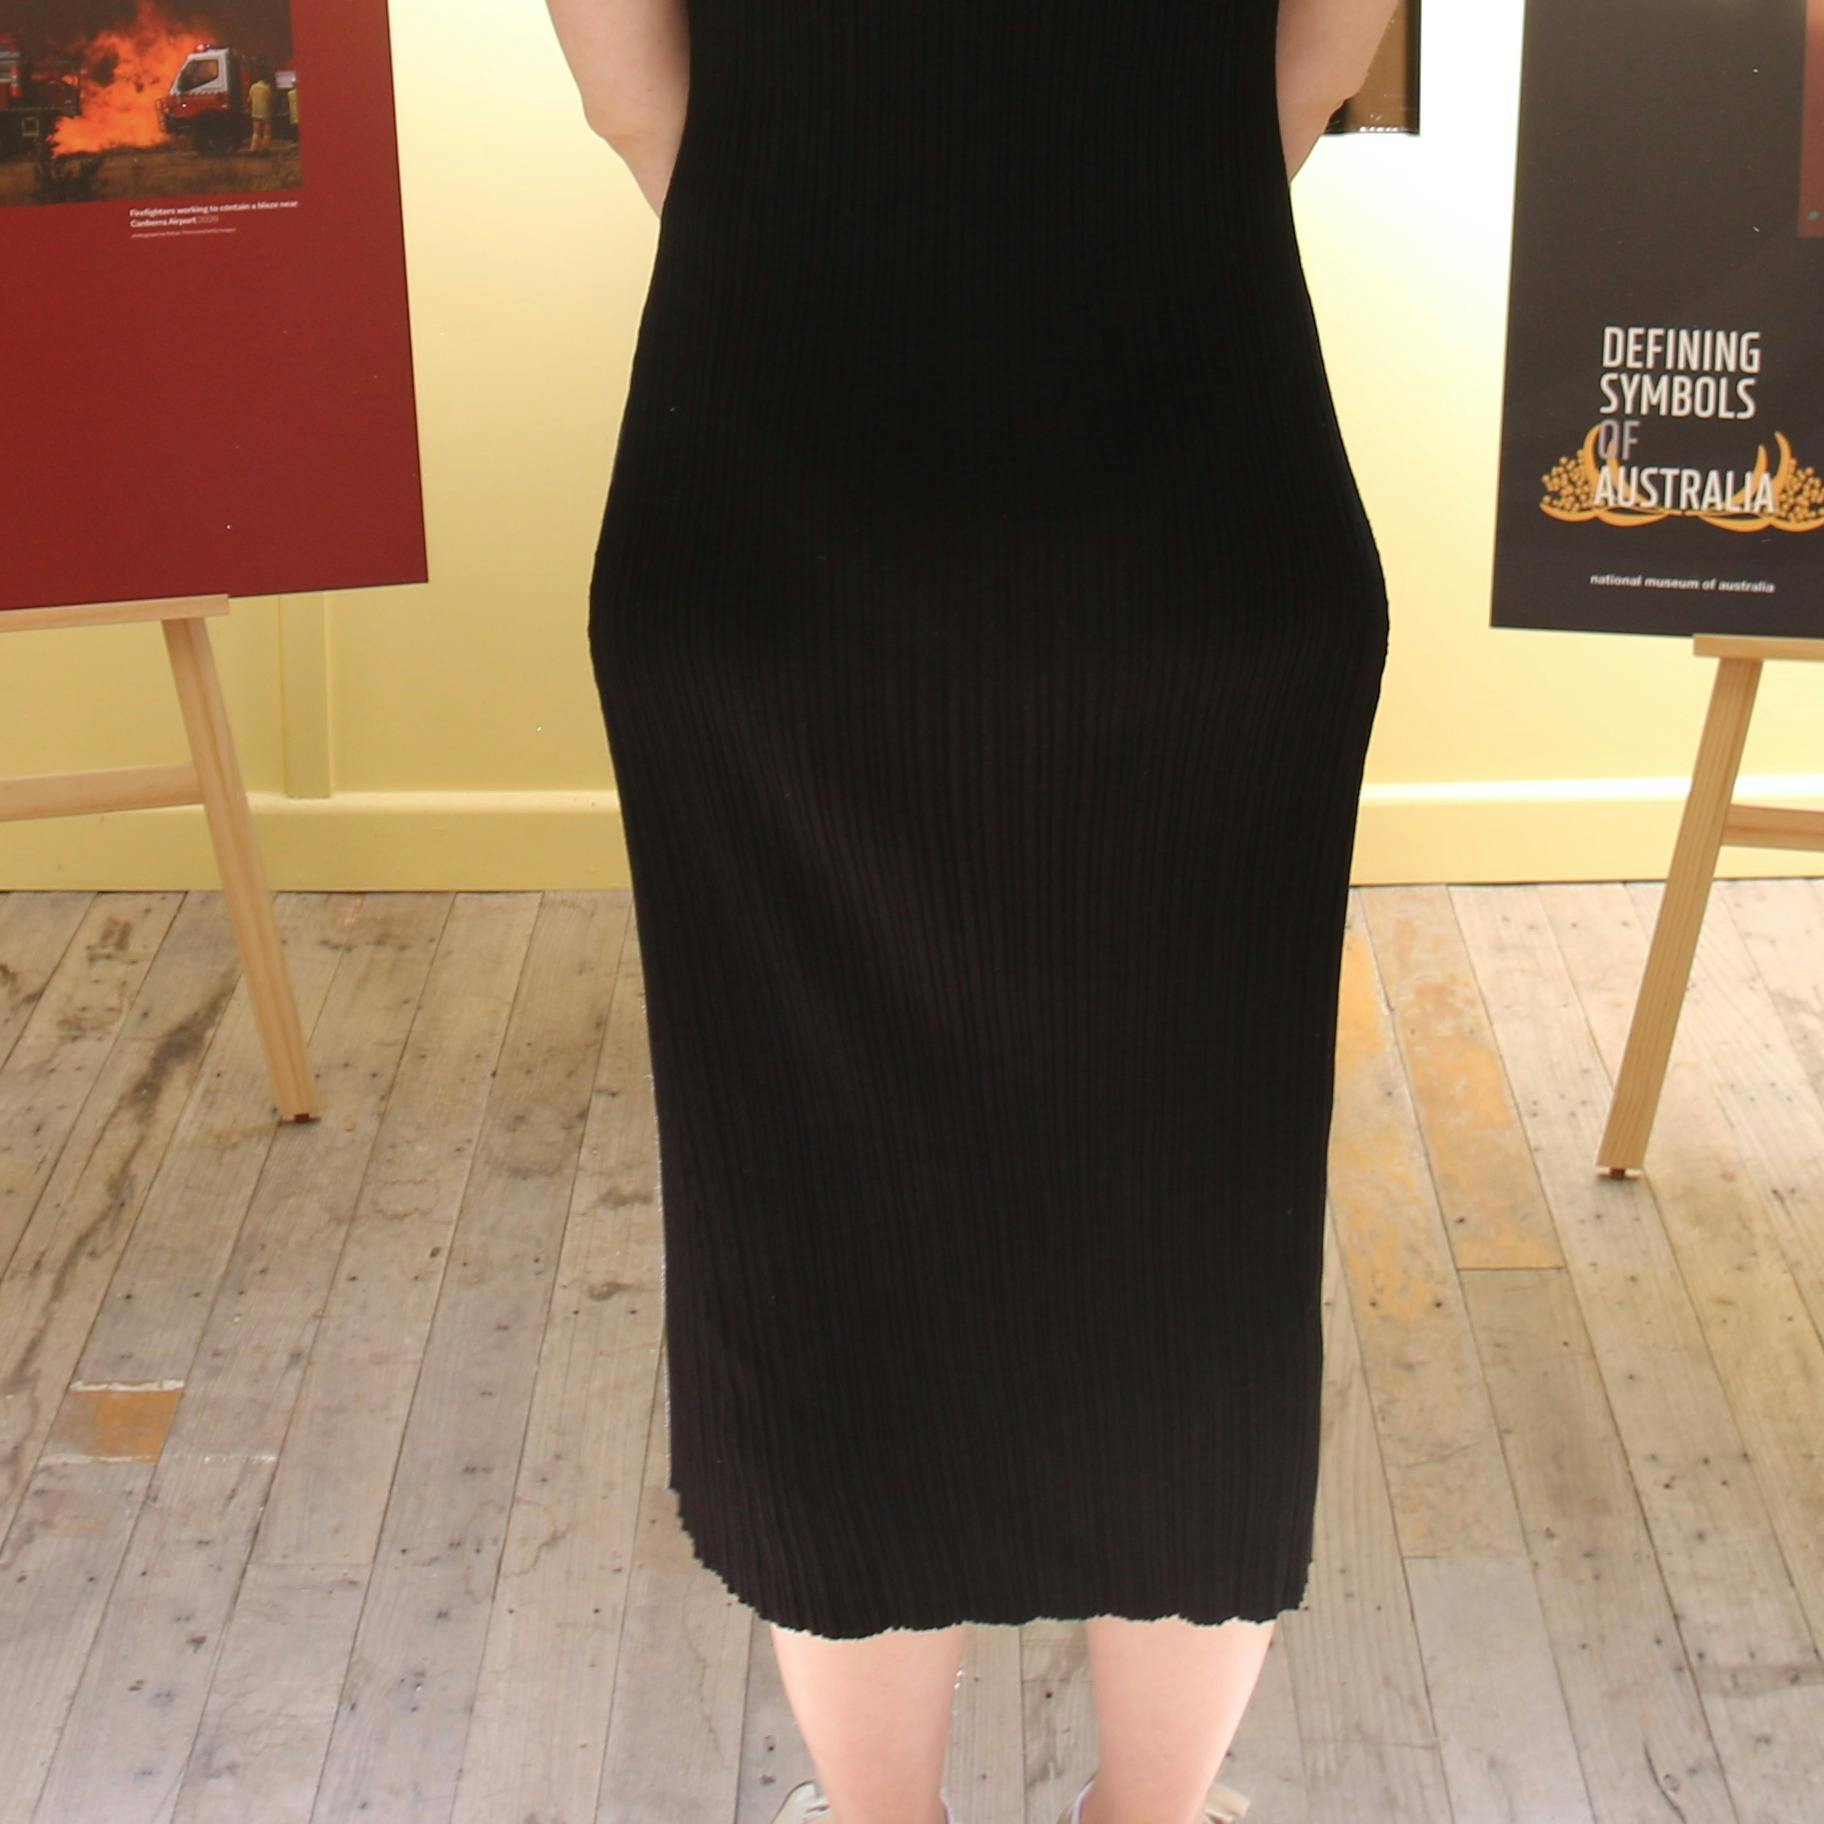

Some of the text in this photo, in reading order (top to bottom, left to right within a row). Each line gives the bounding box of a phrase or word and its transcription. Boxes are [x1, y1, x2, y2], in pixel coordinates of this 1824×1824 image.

[1603, 326, 1761, 373] DEFINING
[1600, 374, 1756, 420] SYMBOLS
[1598, 419, 1640, 460] OF
[1593, 467, 1778, 513] AUSTRALIA
[1591, 575, 1774, 592] national museum of australia
